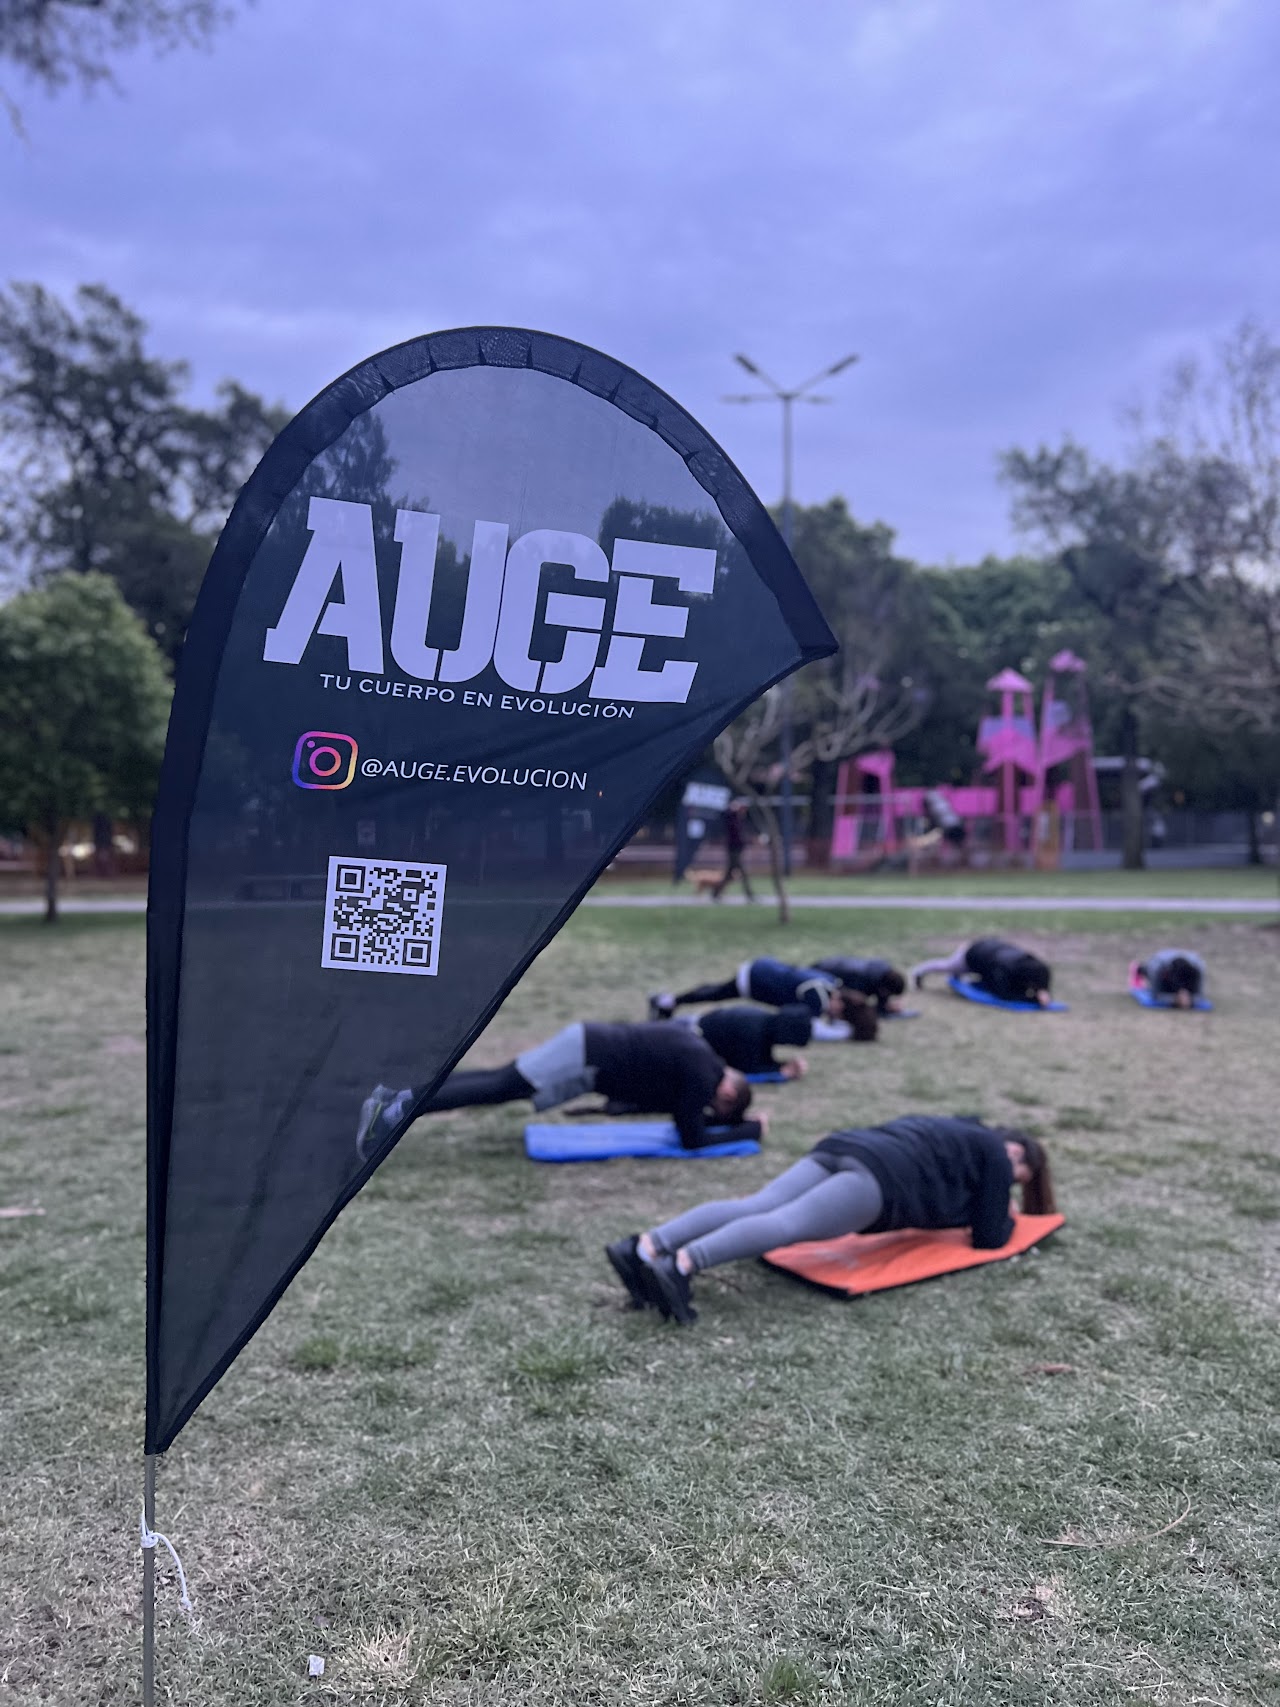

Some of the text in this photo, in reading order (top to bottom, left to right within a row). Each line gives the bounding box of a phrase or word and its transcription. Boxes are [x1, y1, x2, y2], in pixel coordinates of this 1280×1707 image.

[262, 495, 718, 704] AUGE
[319, 673, 635, 719] TU CUERPO EN EVOLUCIÓN
[360, 758, 588, 791] @AUGE.EVOLUCION
